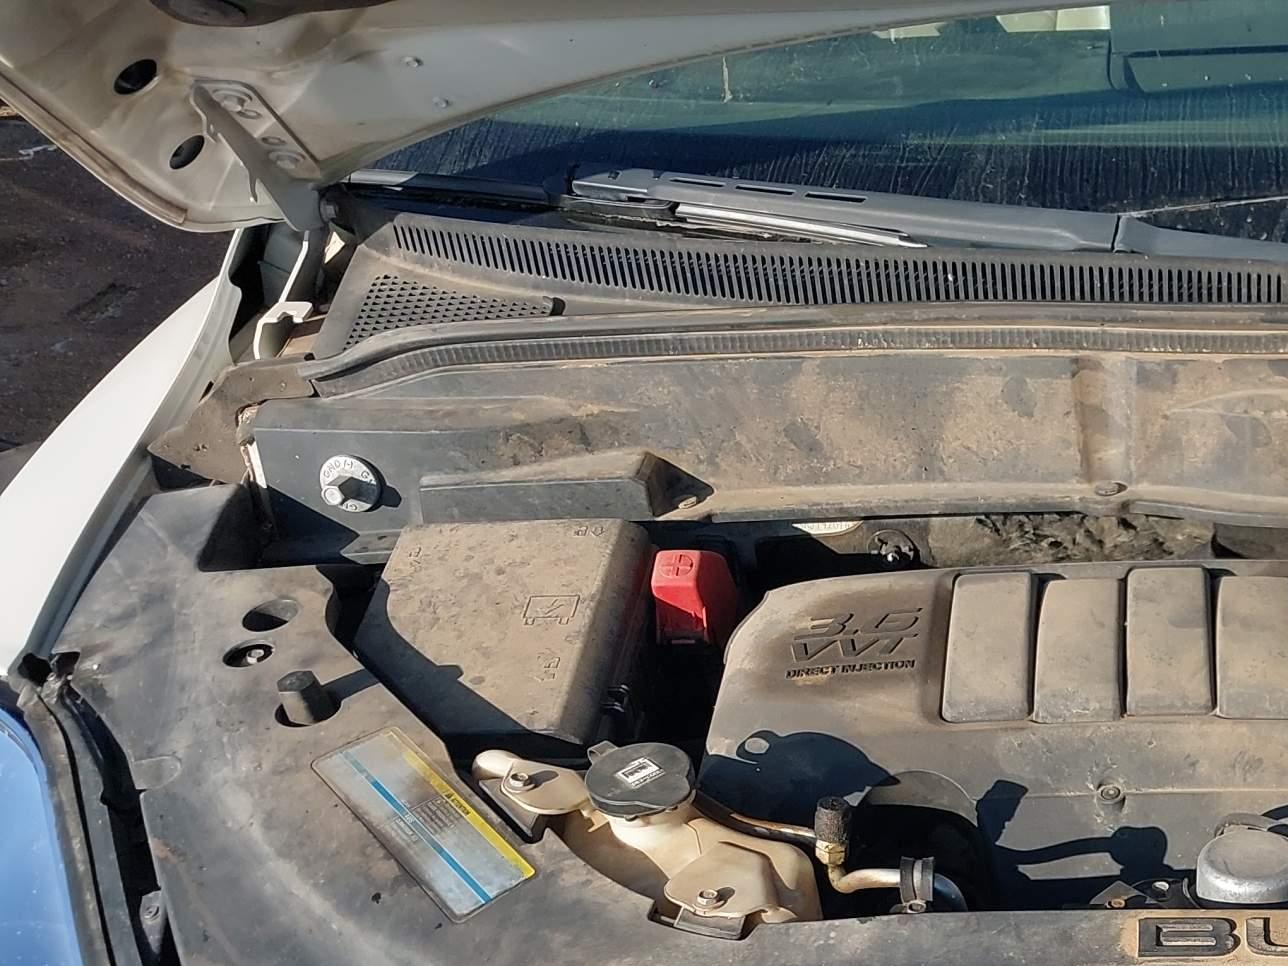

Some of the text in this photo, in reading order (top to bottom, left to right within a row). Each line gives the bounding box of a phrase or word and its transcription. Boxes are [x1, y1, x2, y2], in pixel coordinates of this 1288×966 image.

[793, 607, 924, 641] 3.6
[790, 632, 919, 663] VVT
[785, 658, 916, 680] DIRECT INJECTION
